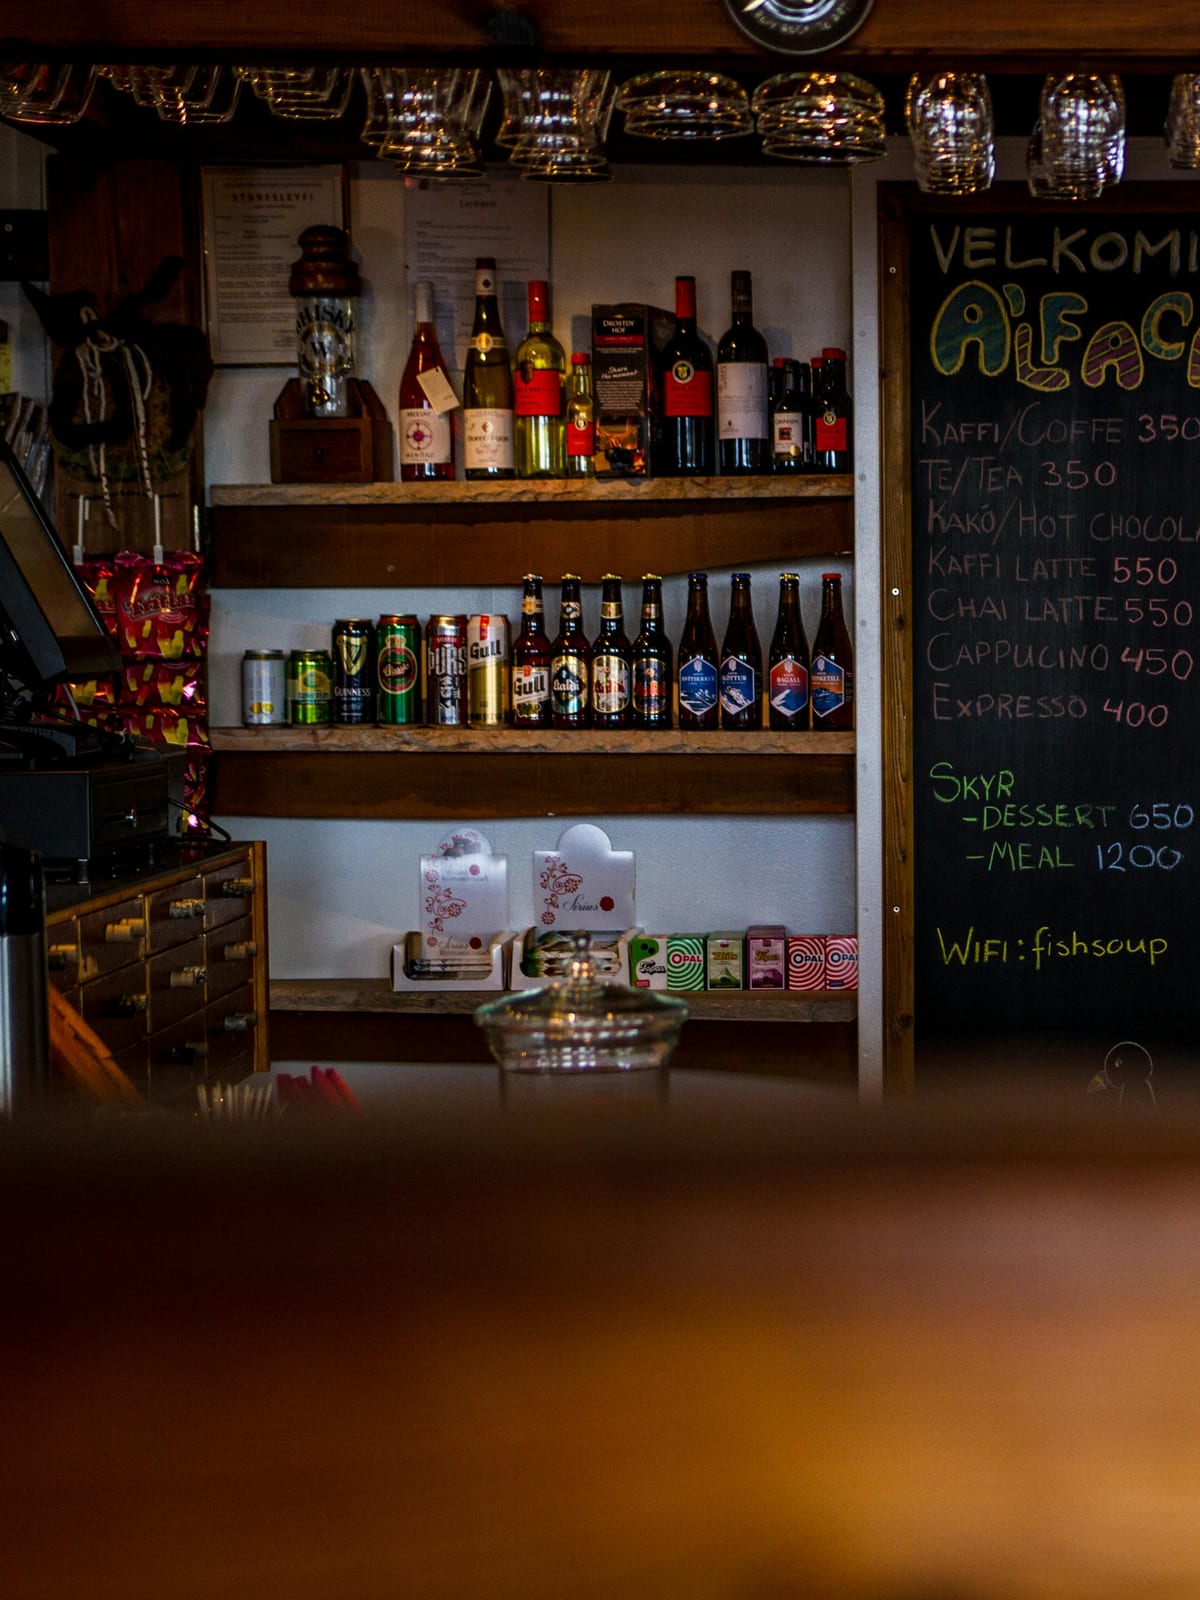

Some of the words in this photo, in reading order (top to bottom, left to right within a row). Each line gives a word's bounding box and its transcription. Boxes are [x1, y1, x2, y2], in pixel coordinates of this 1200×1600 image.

[1041, 460, 1117, 490] 350
[928, 544, 1001, 579] KAFFI
[1015, 555, 1097, 583] LATTE
[1112, 557, 1178, 585] 550
[927, 588, 1008, 622] CHAI
[1024, 595, 1119, 624] LATTE
[1123, 598, 1194, 627] 550
[470, 639, 502, 659] Gull
[926, 633, 1109, 672] CAPPUCINO
[1120, 646, 1195, 681] 450
[334, 686, 373, 697] GUINNESS
[514, 674, 545, 697] Gull
[931, 683, 1089, 722] EXPRESSO
[1103, 698, 1170, 728] 400
[929, 762, 1016, 803] SKYR
[1129, 803, 1195, 831] 650
[1097, 841, 1184, 873] 1200
[671, 954, 702, 964] OPAL
[793, 954, 824, 964] OPAL
